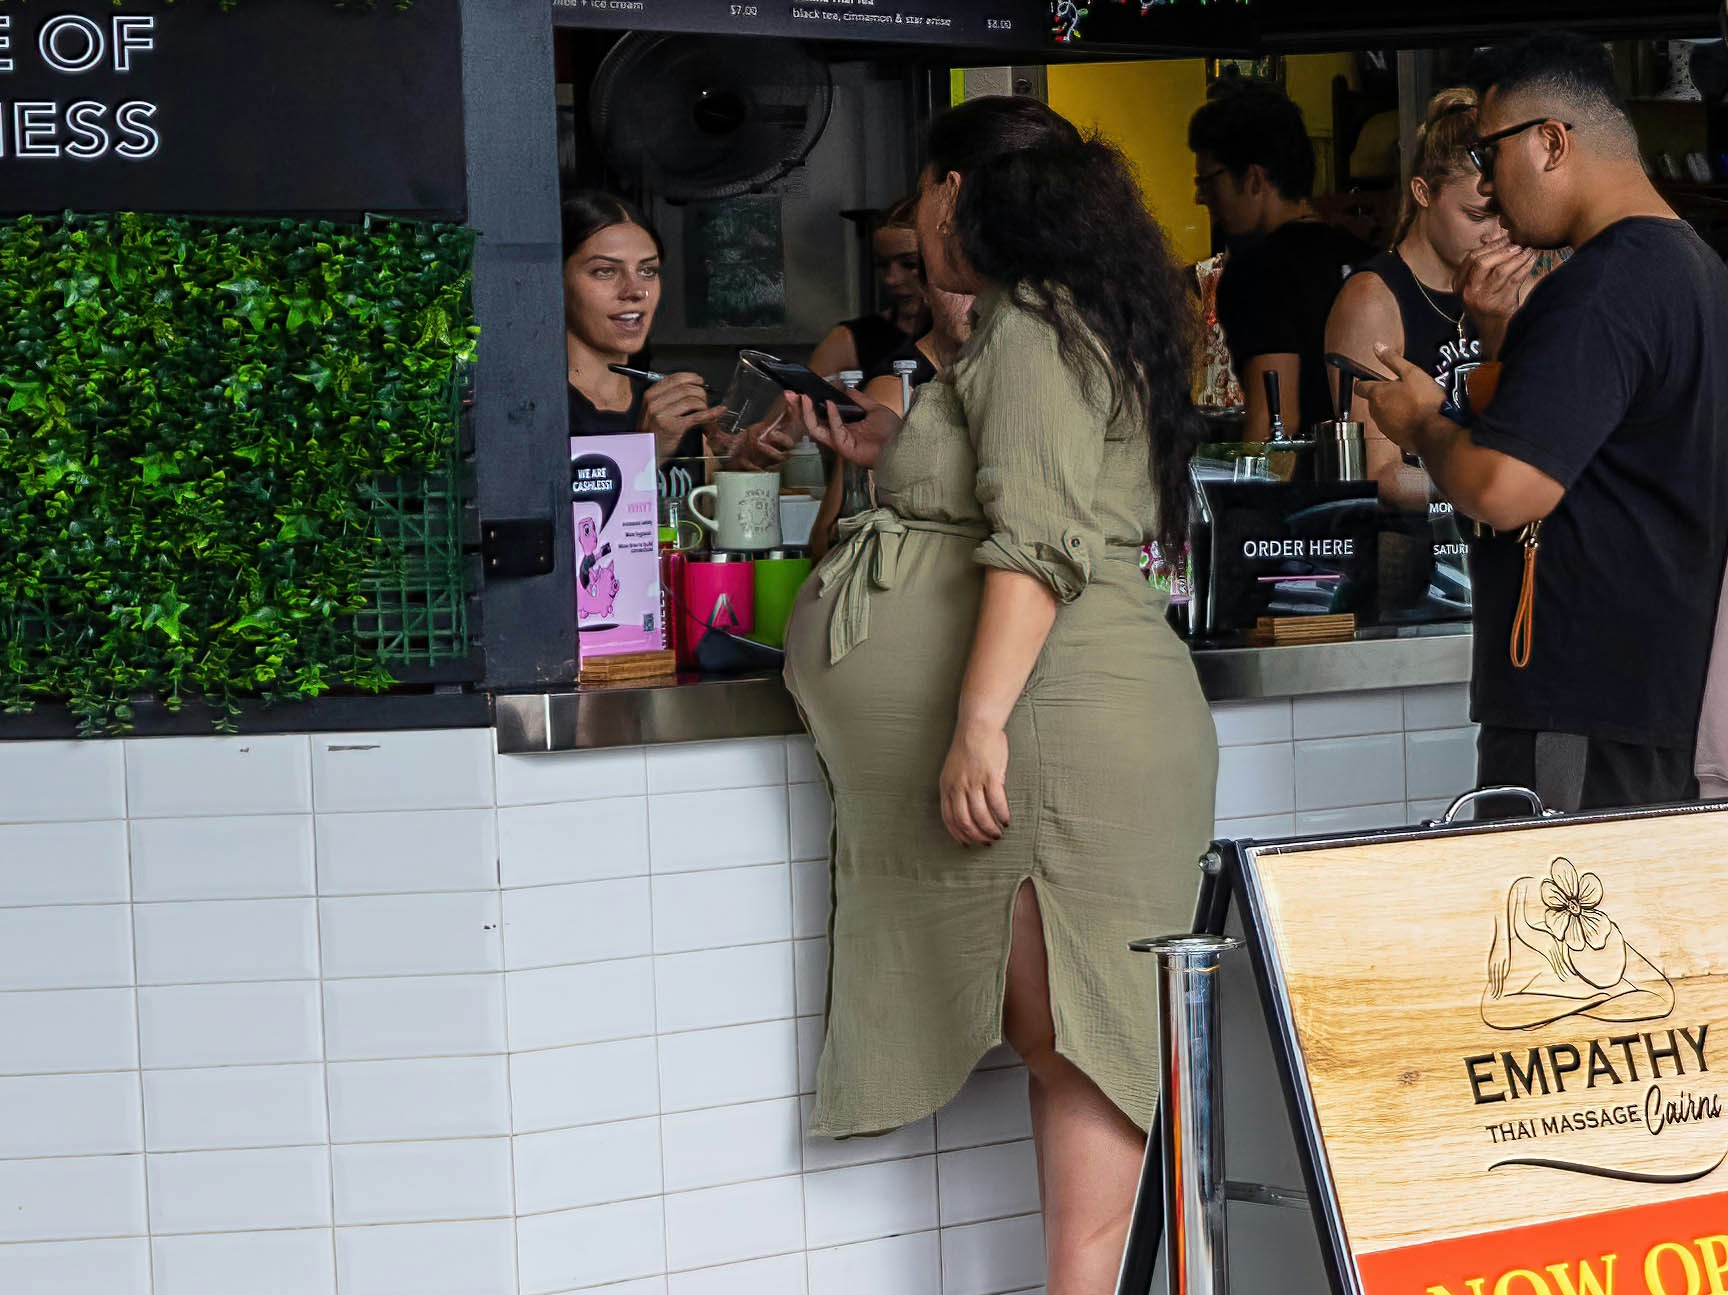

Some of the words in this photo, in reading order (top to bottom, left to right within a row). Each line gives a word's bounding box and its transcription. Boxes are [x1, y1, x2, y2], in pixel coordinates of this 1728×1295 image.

[38, 14, 154, 72] OF
[577, 468, 590, 479] WE
[591, 467, 607, 478] ARE
[1243, 539, 1303, 557] ORDER
[1310, 539, 1354, 556] HERE
[1463, 1023, 1710, 1104] EMPATHY
[1485, 1119, 1538, 1144] THAI
[1541, 1104, 1642, 1135] MASSAGE
[1644, 1084, 1722, 1135] Cairns
